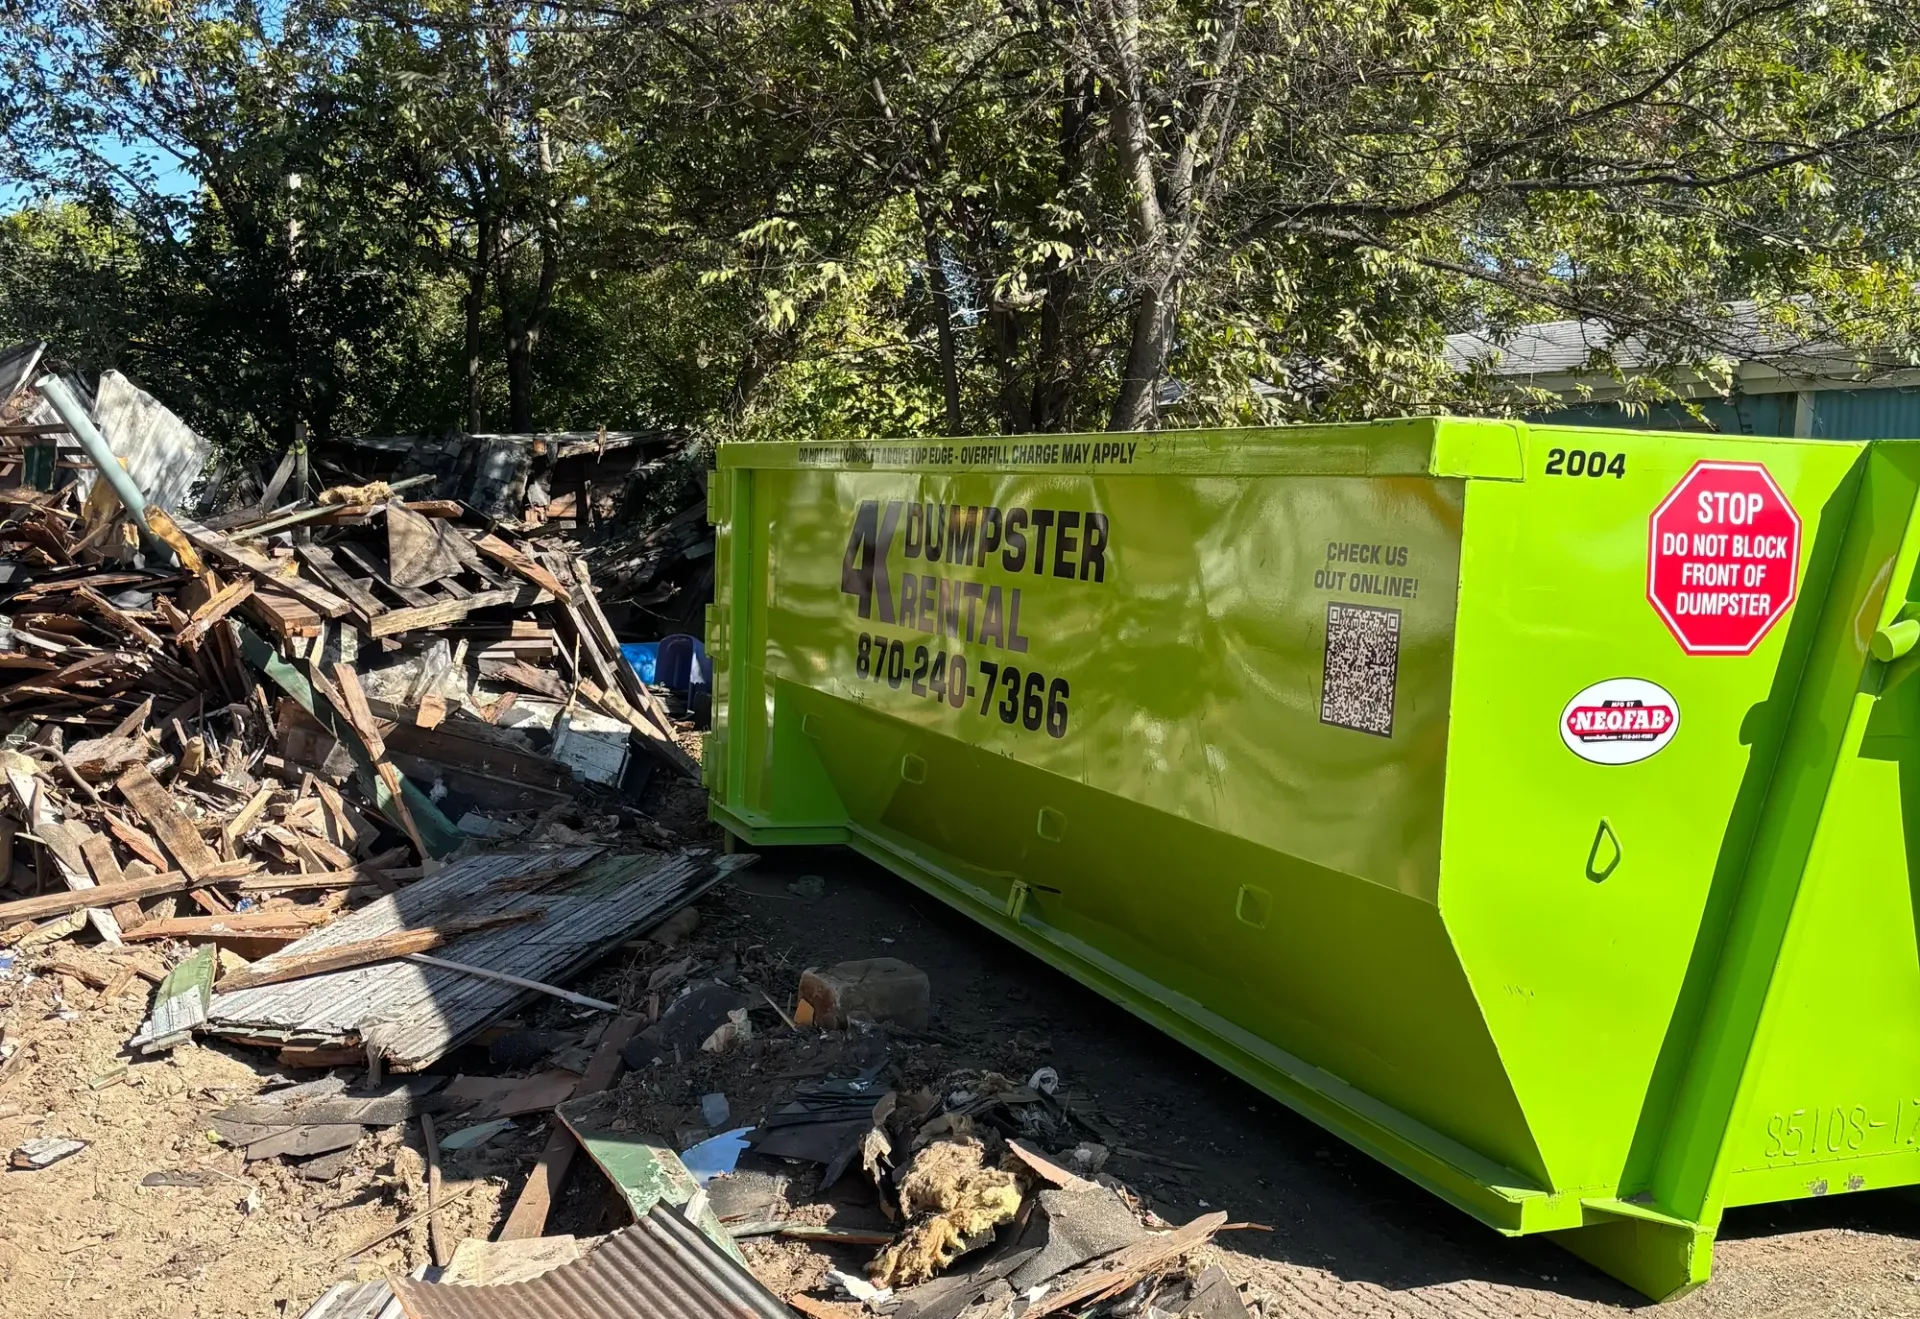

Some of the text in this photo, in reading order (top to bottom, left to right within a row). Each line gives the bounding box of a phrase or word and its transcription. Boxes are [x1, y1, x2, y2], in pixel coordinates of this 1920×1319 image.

[798, 447, 808, 463] DO
[809, 447, 823, 464] NOT
[824, 447, 839, 463] FILL
[881, 446, 909, 465] ABOVE
[911, 446, 927, 465] TOP
[929, 446, 954, 465] EDGE
[961, 445, 1009, 465] OVERFILL
[1011, 443, 1058, 465] CHARGE
[1061, 443, 1091, 464] MAY
[1091, 442, 1137, 464] APPLY
[1545, 448, 1627, 479] 2004
[1697, 490, 1764, 525] STOP
[1326, 541, 1409, 567] CHECK US
[1662, 532, 1788, 559] DO NOT BLOCK
[841, 500, 1109, 625] 4K DUMPSTER
[1681, 562, 1767, 588] FRONT OF
[1314, 569, 1419, 599] OUT ONLINE!
[899, 571, 1029, 653] RENTAL
[1675, 592, 1771, 616] DUMPSTER
[856, 631, 1070, 739] 870-240-7366
[1574, 709, 1666, 731] NEOFAB
